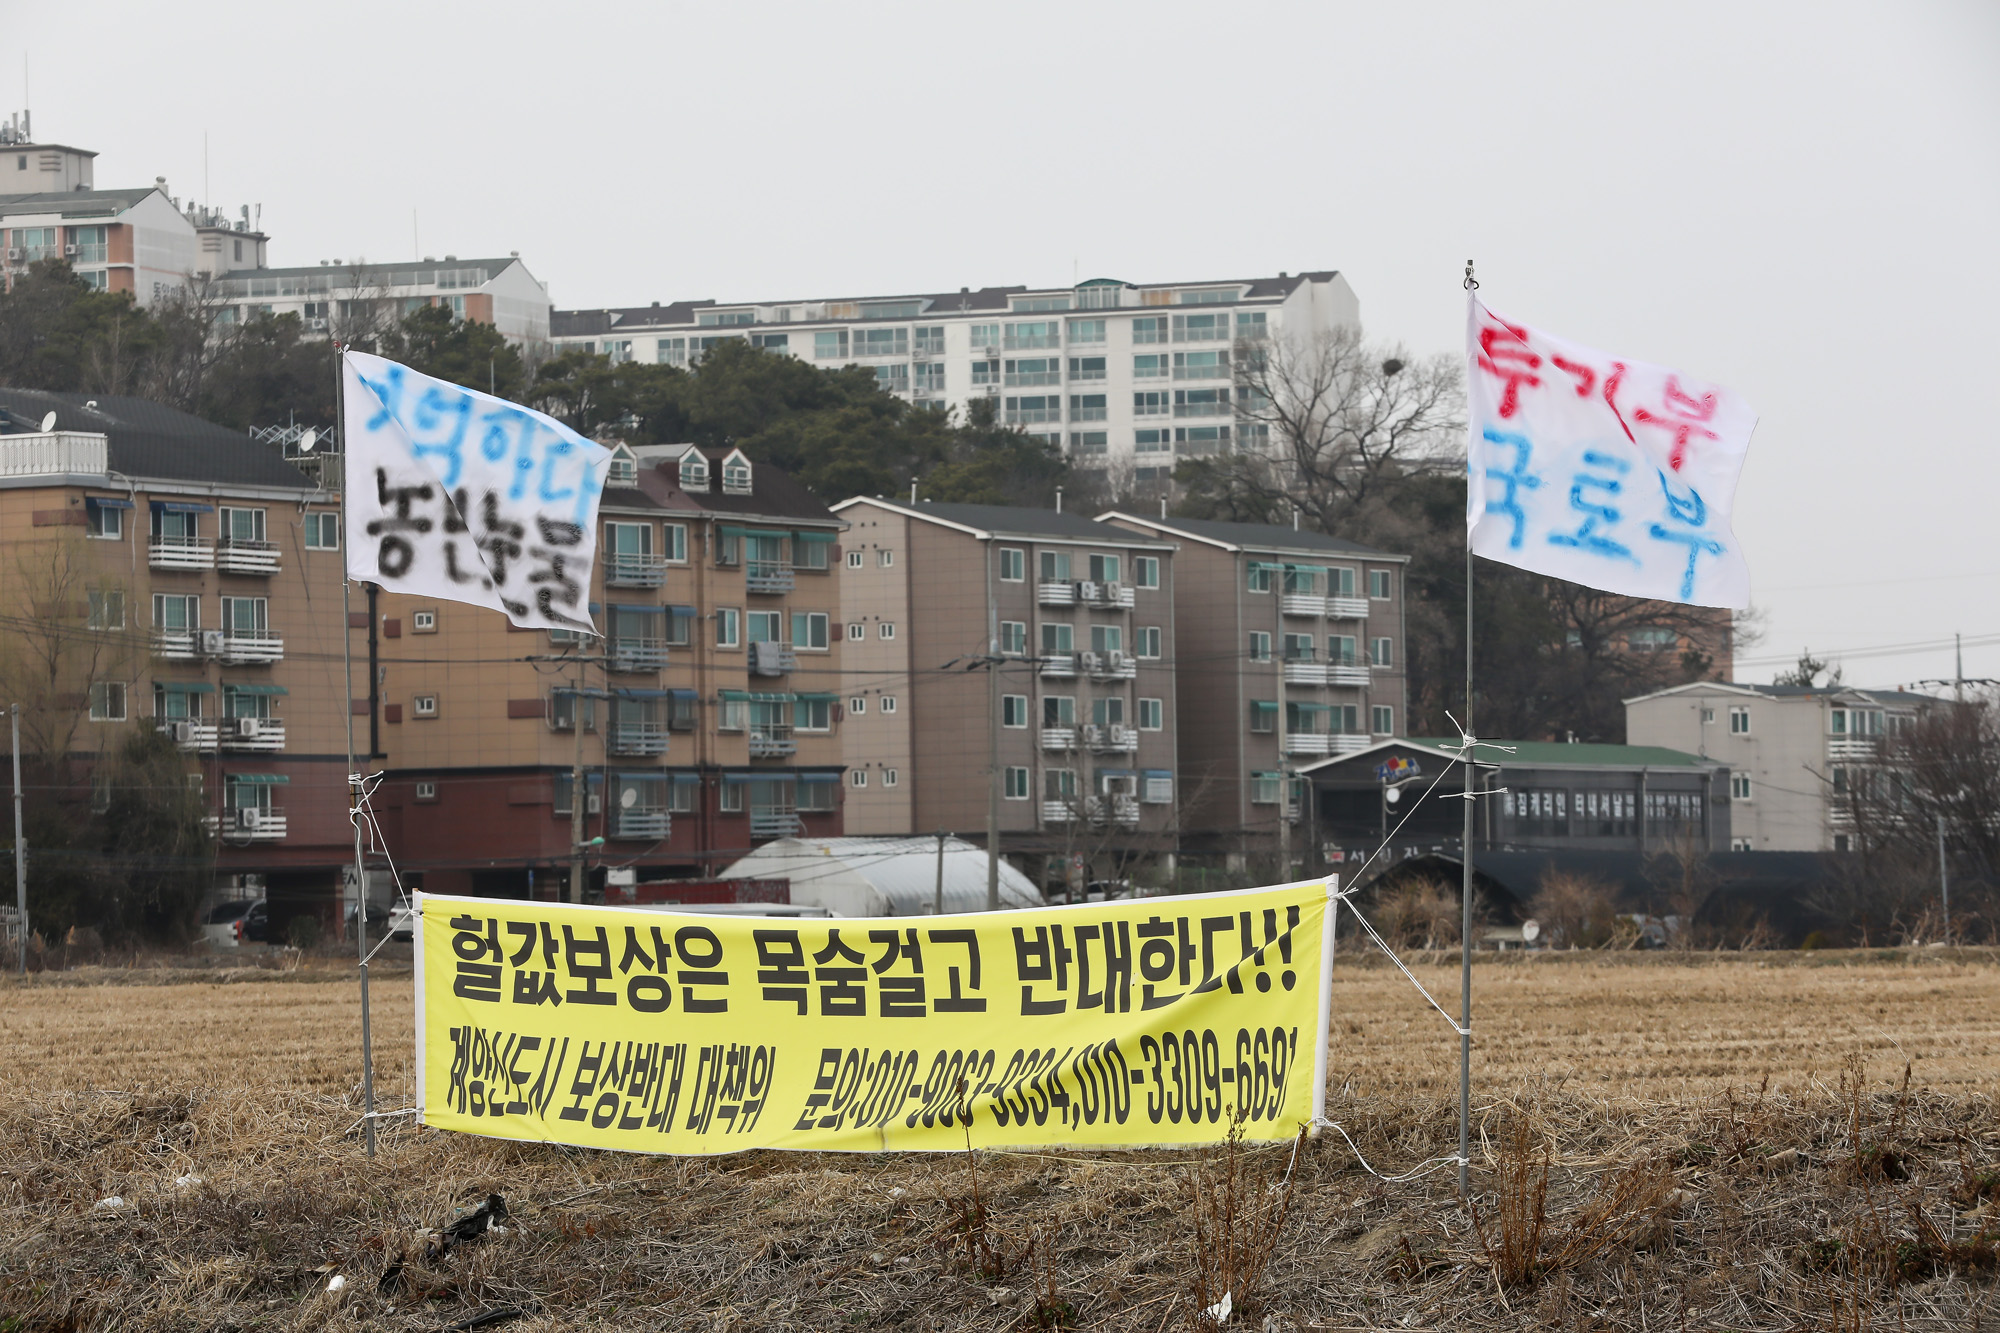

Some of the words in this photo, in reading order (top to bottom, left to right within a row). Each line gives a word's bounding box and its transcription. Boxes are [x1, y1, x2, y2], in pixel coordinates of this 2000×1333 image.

[1477, 318, 1722, 474] 투기부
[1482, 422, 1730, 600] 국토부
[450, 914, 729, 1013] 헐값보상은
[753, 928, 987, 1018] 목숨걸고
[1012, 905, 1300, 1016] 반대한다!!
[447, 1025, 570, 1121] 계양신도시
[559, 1040, 686, 1131] 보상반대
[685, 1042, 776, 1135] 대책위
